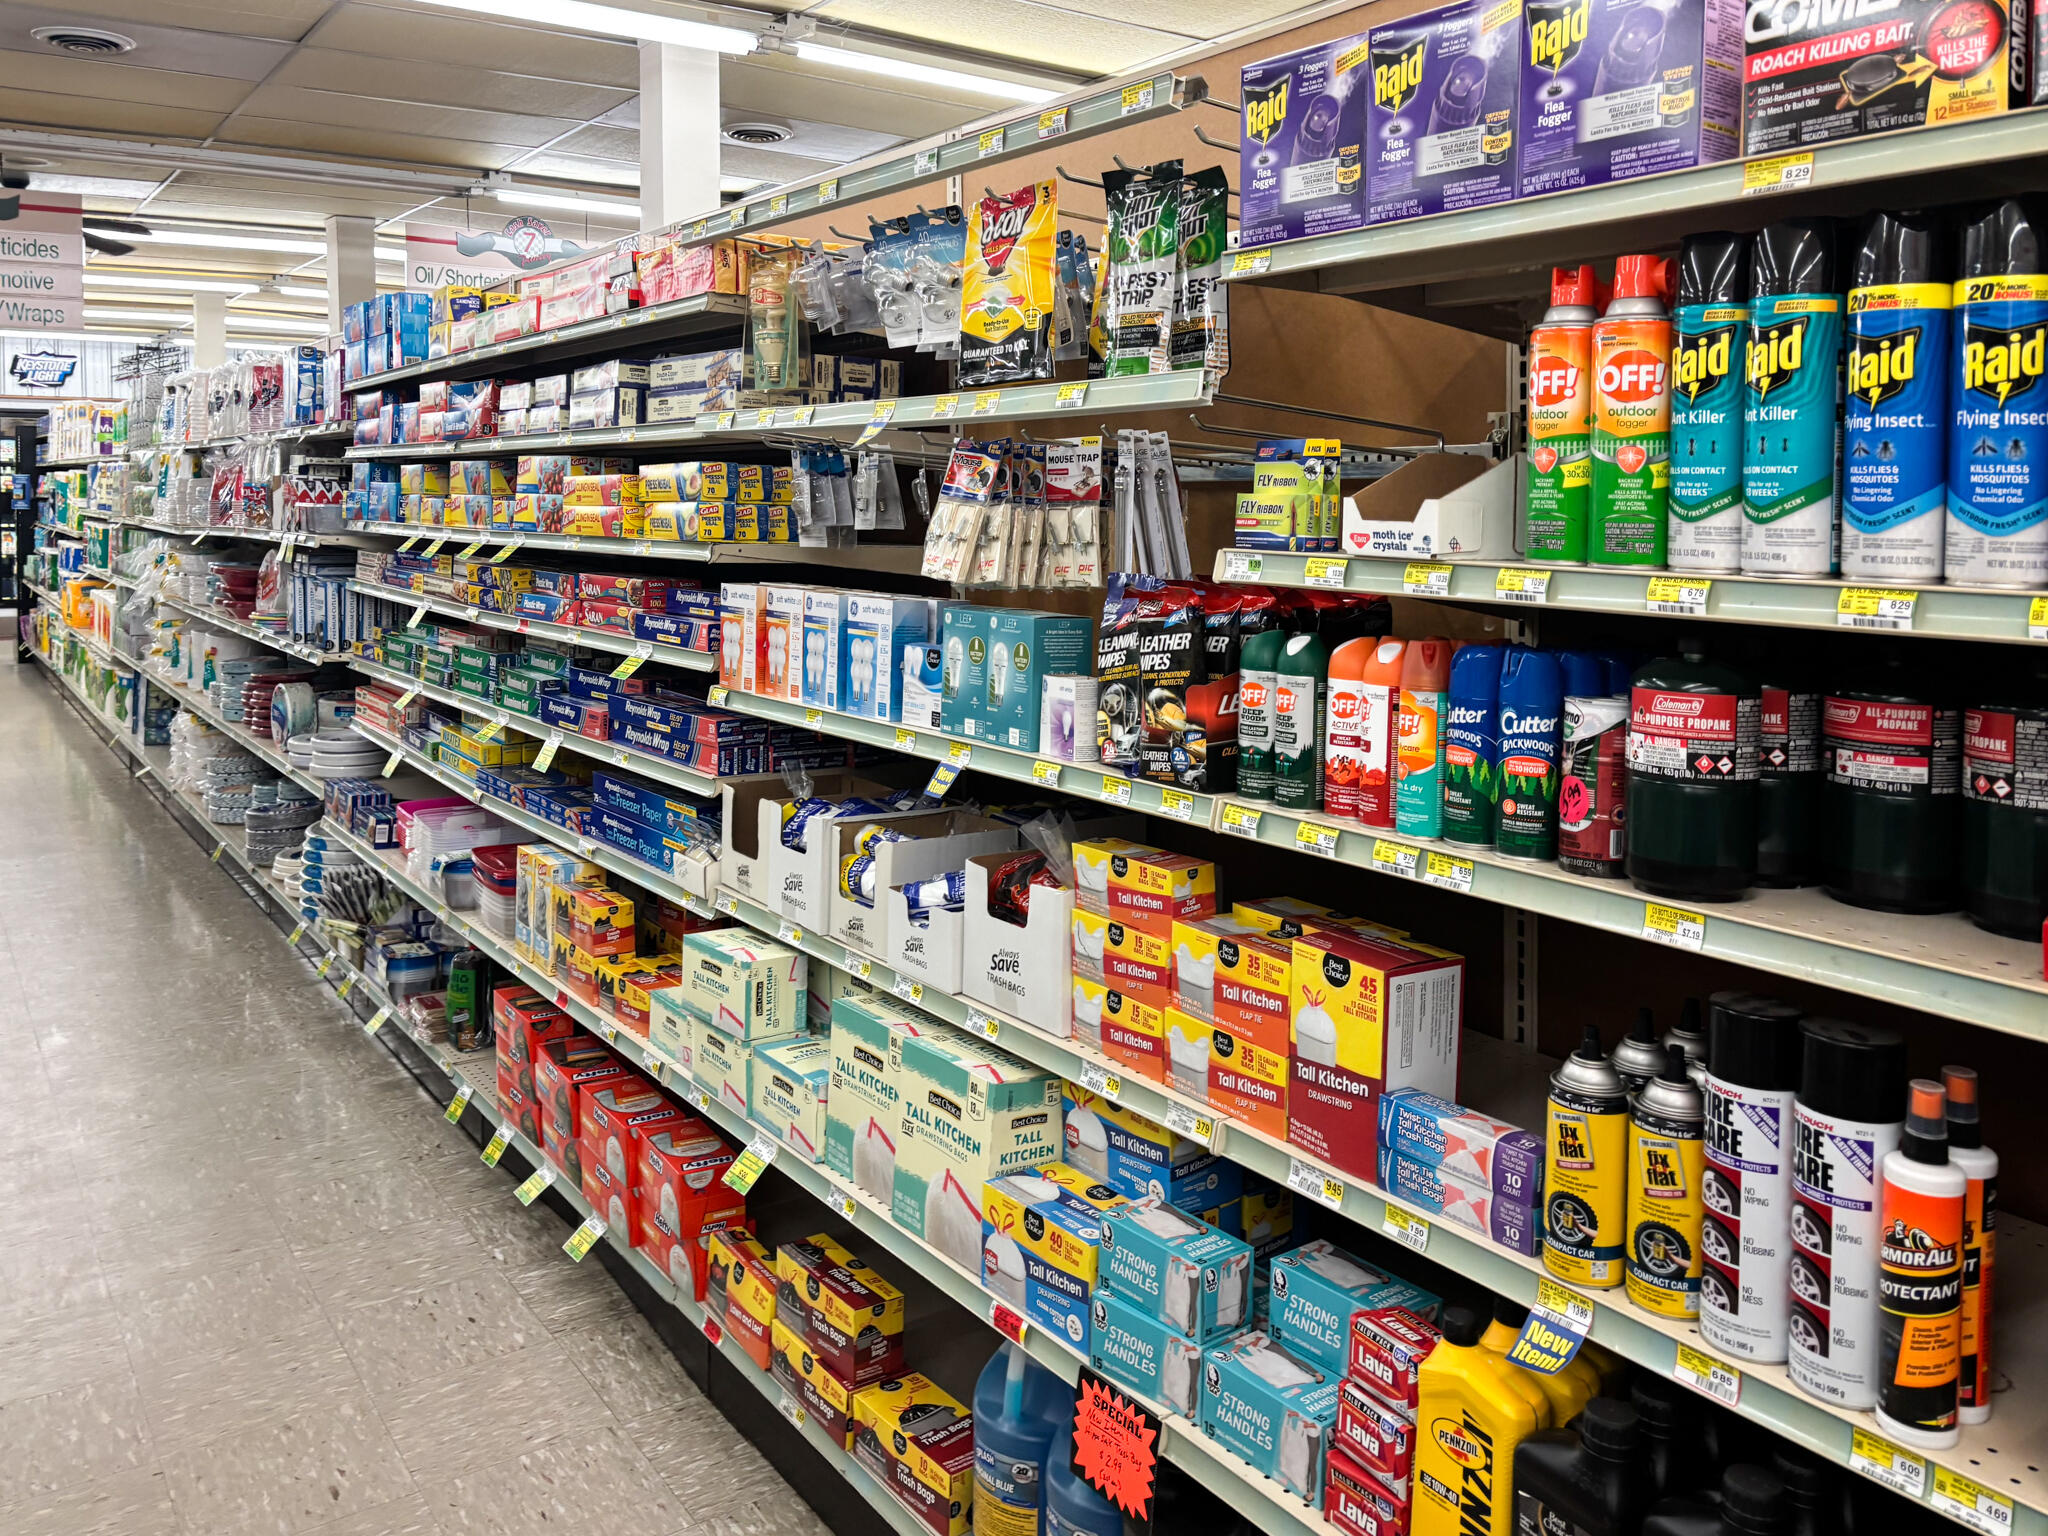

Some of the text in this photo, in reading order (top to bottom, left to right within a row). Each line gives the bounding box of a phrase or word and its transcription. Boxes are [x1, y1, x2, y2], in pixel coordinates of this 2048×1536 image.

[1530, 1, 1588, 66] Raid
[1937, 33, 1988, 56] KILLS THE
[1751, 31, 1871, 76] ROACH KILLING
[1940, 48, 1986, 70] NEST
[1374, 45, 1426, 106] Raid
[1757, 82, 1784, 94] Kills Fast
[1802, 86, 1814, 96] Bait
[1815, 81, 1841, 94] Stations
[1246, 84, 1287, 139] Raid
[1544, 101, 1565, 114] Flea
[1767, 104, 1782, 116] Mess
[1805, 97, 1820, 108] Odor
[1934, 107, 1947, 120] 12
[1538, 110, 1573, 128] Fogger
[1387, 139, 1404, 150] Flea
[1381, 148, 1410, 162] Fogger
[1257, 169, 1272, 179] Flea
[1253, 176, 1277, 190] Fogger
[504, 217, 552, 236] Cash Saver
[524, 232, 536, 252] 7
[1994, 290, 2033, 300] BONUS!
[1868, 299, 1902, 309] BONUS!
[962, 344, 1013, 359] GUARANTEED TO
[1965, 328, 2045, 390] Raid
[17, 358, 74, 371] KEYSTONE
[1848, 335, 1915, 395] Raid
[27, 370, 63, 382] LIGHT
[1600, 363, 1666, 395] OFF!
[1608, 406, 1658, 417] outdoor
[1689, 411, 1726, 424] Killer
[1760, 407, 1798, 421] Killer
[1956, 409, 2000, 429] Flying
[1535, 421, 1558, 431] fogger
[1616, 418, 1648, 429] fogger
[1875, 413, 1924, 428] Insect
[1048, 453, 1099, 464] MOUSE TRAP
[518, 460, 532, 473] GLAD
[703, 464, 722, 473] GLAD
[739, 469, 757, 478] GLAD
[1763, 465, 1798, 474] CONTACT
[1970, 464, 2019, 474] KILLS FLIES
[1257, 475, 1298, 487] FLY RIBBON
[1970, 474, 2030, 484] MOSQUITOES
[700, 506, 719, 515] GLAD
[1240, 500, 1284, 514] FLY RIBBON
[1372, 530, 1394, 540] moth
[1373, 541, 1408, 552] crystals
[582, 581, 600, 596] SARAN
[644, 615, 676, 633] Reynolds Wrap
[1140, 632, 1192, 652] LEATHER
[1331, 699, 1361, 714] OFF!
[1656, 698, 1691, 710] Coleman
[1242, 708, 1264, 716] DEEP
[1866, 706, 1927, 720] ALL-PURPOSE
[1332, 721, 1359, 730] ACTIVE
[1501, 711, 1558, 735] Cutter
[1688, 718, 1730, 731] PROPANE
[1877, 719, 1918, 731] PROPANE
[625, 728, 669, 754] Reynolds Wrap
[1503, 738, 1554, 757] BACKWOODS
[1655, 738, 1681, 747] DANGER
[1970, 736, 2007, 752] PROPANE
[1142, 750, 1168, 761] LEATHER
[1866, 754, 1895, 764] DANGER
[1150, 760, 1171, 772] WIPES
[616, 794, 662, 824] Freezer Paper
[613, 829, 659, 861] Freezer Paper
[783, 877, 805, 892] Save
[1117, 892, 1163, 910] Tall Kitchen
[999, 948, 1020, 960] Always
[1248, 954, 1260, 970] 35
[1328, 959, 1343, 972] Best
[1246, 968, 1261, 980] BAGS
[986, 974, 1026, 997] TRASH BAGS
[1359, 975, 1377, 994] 45
[1221, 984, 1282, 1012] Tall Kitchen
[1359, 991, 1377, 1003] BAGS
[835, 1057, 856, 1077] TALL
[1296, 1062, 1369, 1097] Tall Kitchen
[1710, 1081, 1742, 1100] TOUCH
[1308, 1090, 1352, 1111] DRAWSTRING
[1398, 1108, 1436, 1129] Twist Tie
[905, 1102, 981, 1156] TALL KITCHEN
[1396, 1117, 1447, 1144] Tall Kitchen
[1014, 1130, 1043, 1144] TALL
[1396, 1126, 1446, 1154] Trash Bags
[1110, 1131, 1163, 1162] Tall Kitchen
[1000, 1144, 1055, 1165] KITCHEN
[1740, 1162, 1772, 1174] PROTECTS
[1503, 1172, 1522, 1189] 10
[1502, 1184, 1521, 1198] COUNT
[1744, 1195, 1769, 1207] WIPING
[654, 1211, 671, 1237] Hefty
[1050, 1231, 1062, 1249] 40
[1743, 1245, 1775, 1258] RUBBING
[1115, 1246, 1157, 1277] STRONG
[1028, 1260, 1082, 1297] Tall Kitchen
[1110, 1263, 1160, 1295] HANDLES
[1633, 1266, 1689, 1291] COMPACT CAR
[1355, 1322, 1392, 1350] VALUE PACK
[1524, 1320, 1575, 1357] New
[1511, 1340, 1566, 1372] Item!
[1357, 1344, 1394, 1385] Lava
[1093, 1395, 1142, 1439] SPECIAL
[1221, 1391, 1271, 1430] STRONG
[1216, 1408, 1273, 1451] HANDLES
[1345, 1413, 1380, 1458] Lava
[1438, 1429, 1480, 1458] PENNZOIL
[896, 1468, 935, 1504] Trash Bags
[996, 1480, 1014, 1493] BLUE
